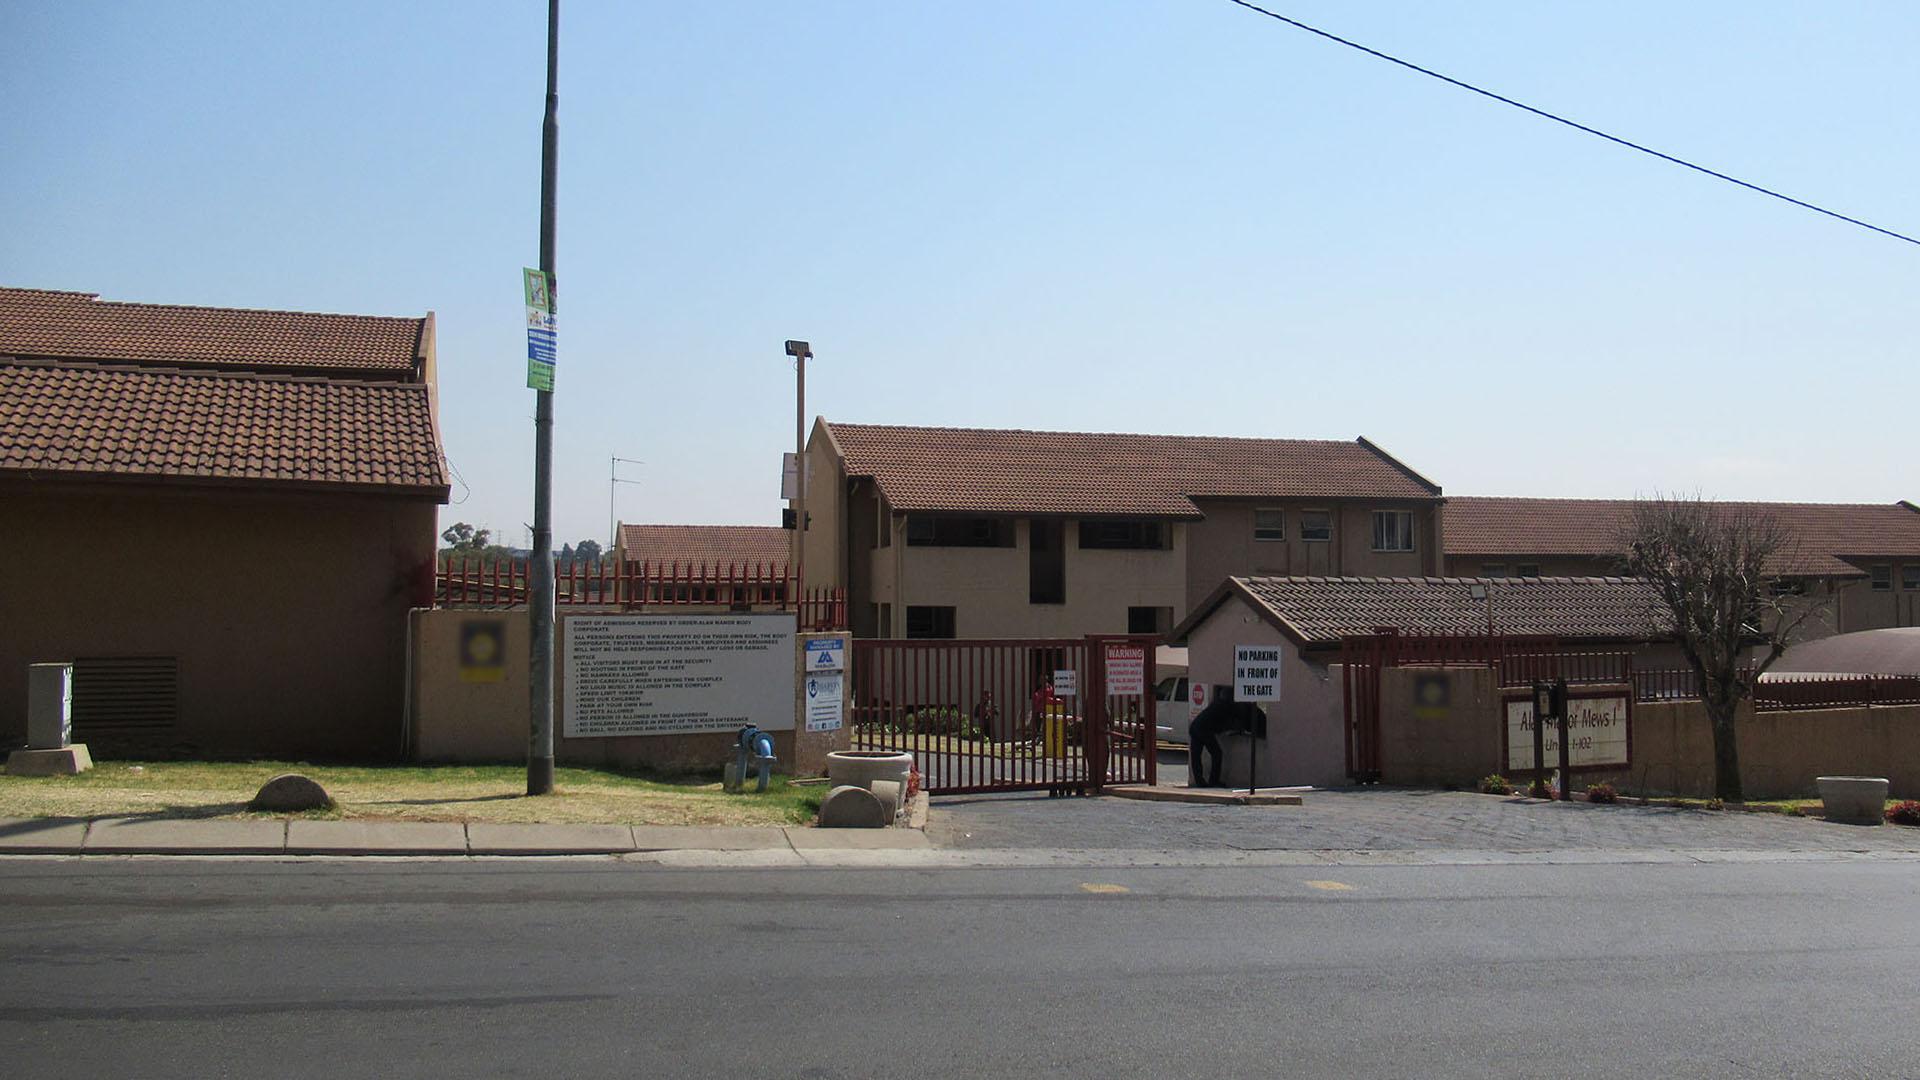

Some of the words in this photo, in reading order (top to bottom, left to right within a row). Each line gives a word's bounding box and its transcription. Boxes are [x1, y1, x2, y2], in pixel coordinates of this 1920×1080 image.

[1108, 649, 1143, 658] WARNING
[1238, 651, 1247, 661] NO
[1249, 651, 1278, 661] PARKING
[1238, 668, 1245, 678] IN
[1248, 668, 1269, 678] FRONT
[1270, 668, 1278, 678] OF
[1243, 685, 1255, 695] THE
[1256, 685, 1272, 696] GATE
[1582, 709, 1609, 728] Mews
